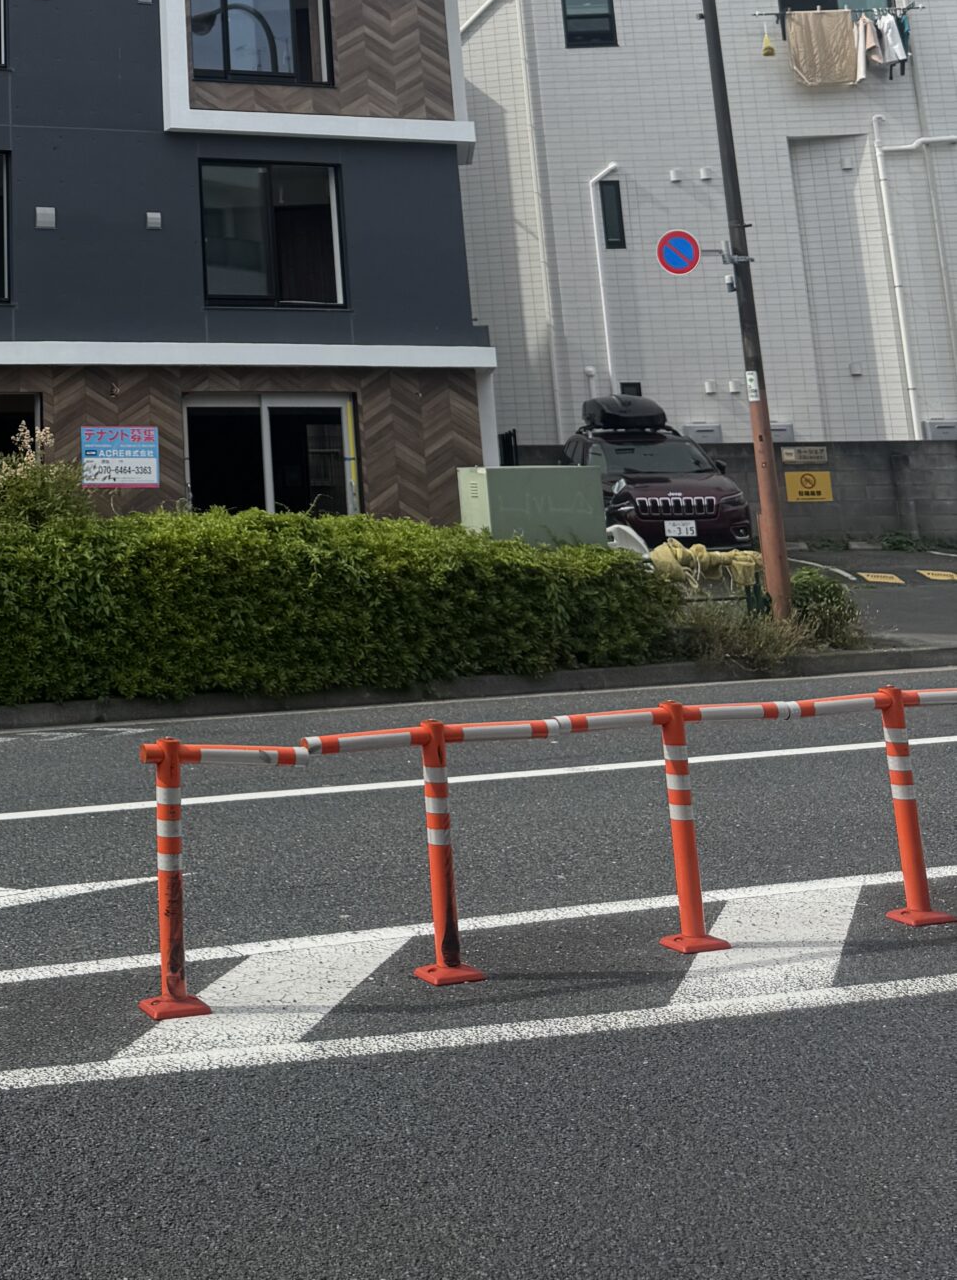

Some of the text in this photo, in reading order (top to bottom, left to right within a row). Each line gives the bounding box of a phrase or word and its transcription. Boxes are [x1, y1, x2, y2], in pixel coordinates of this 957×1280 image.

[84, 428, 155, 442] テナント募集
